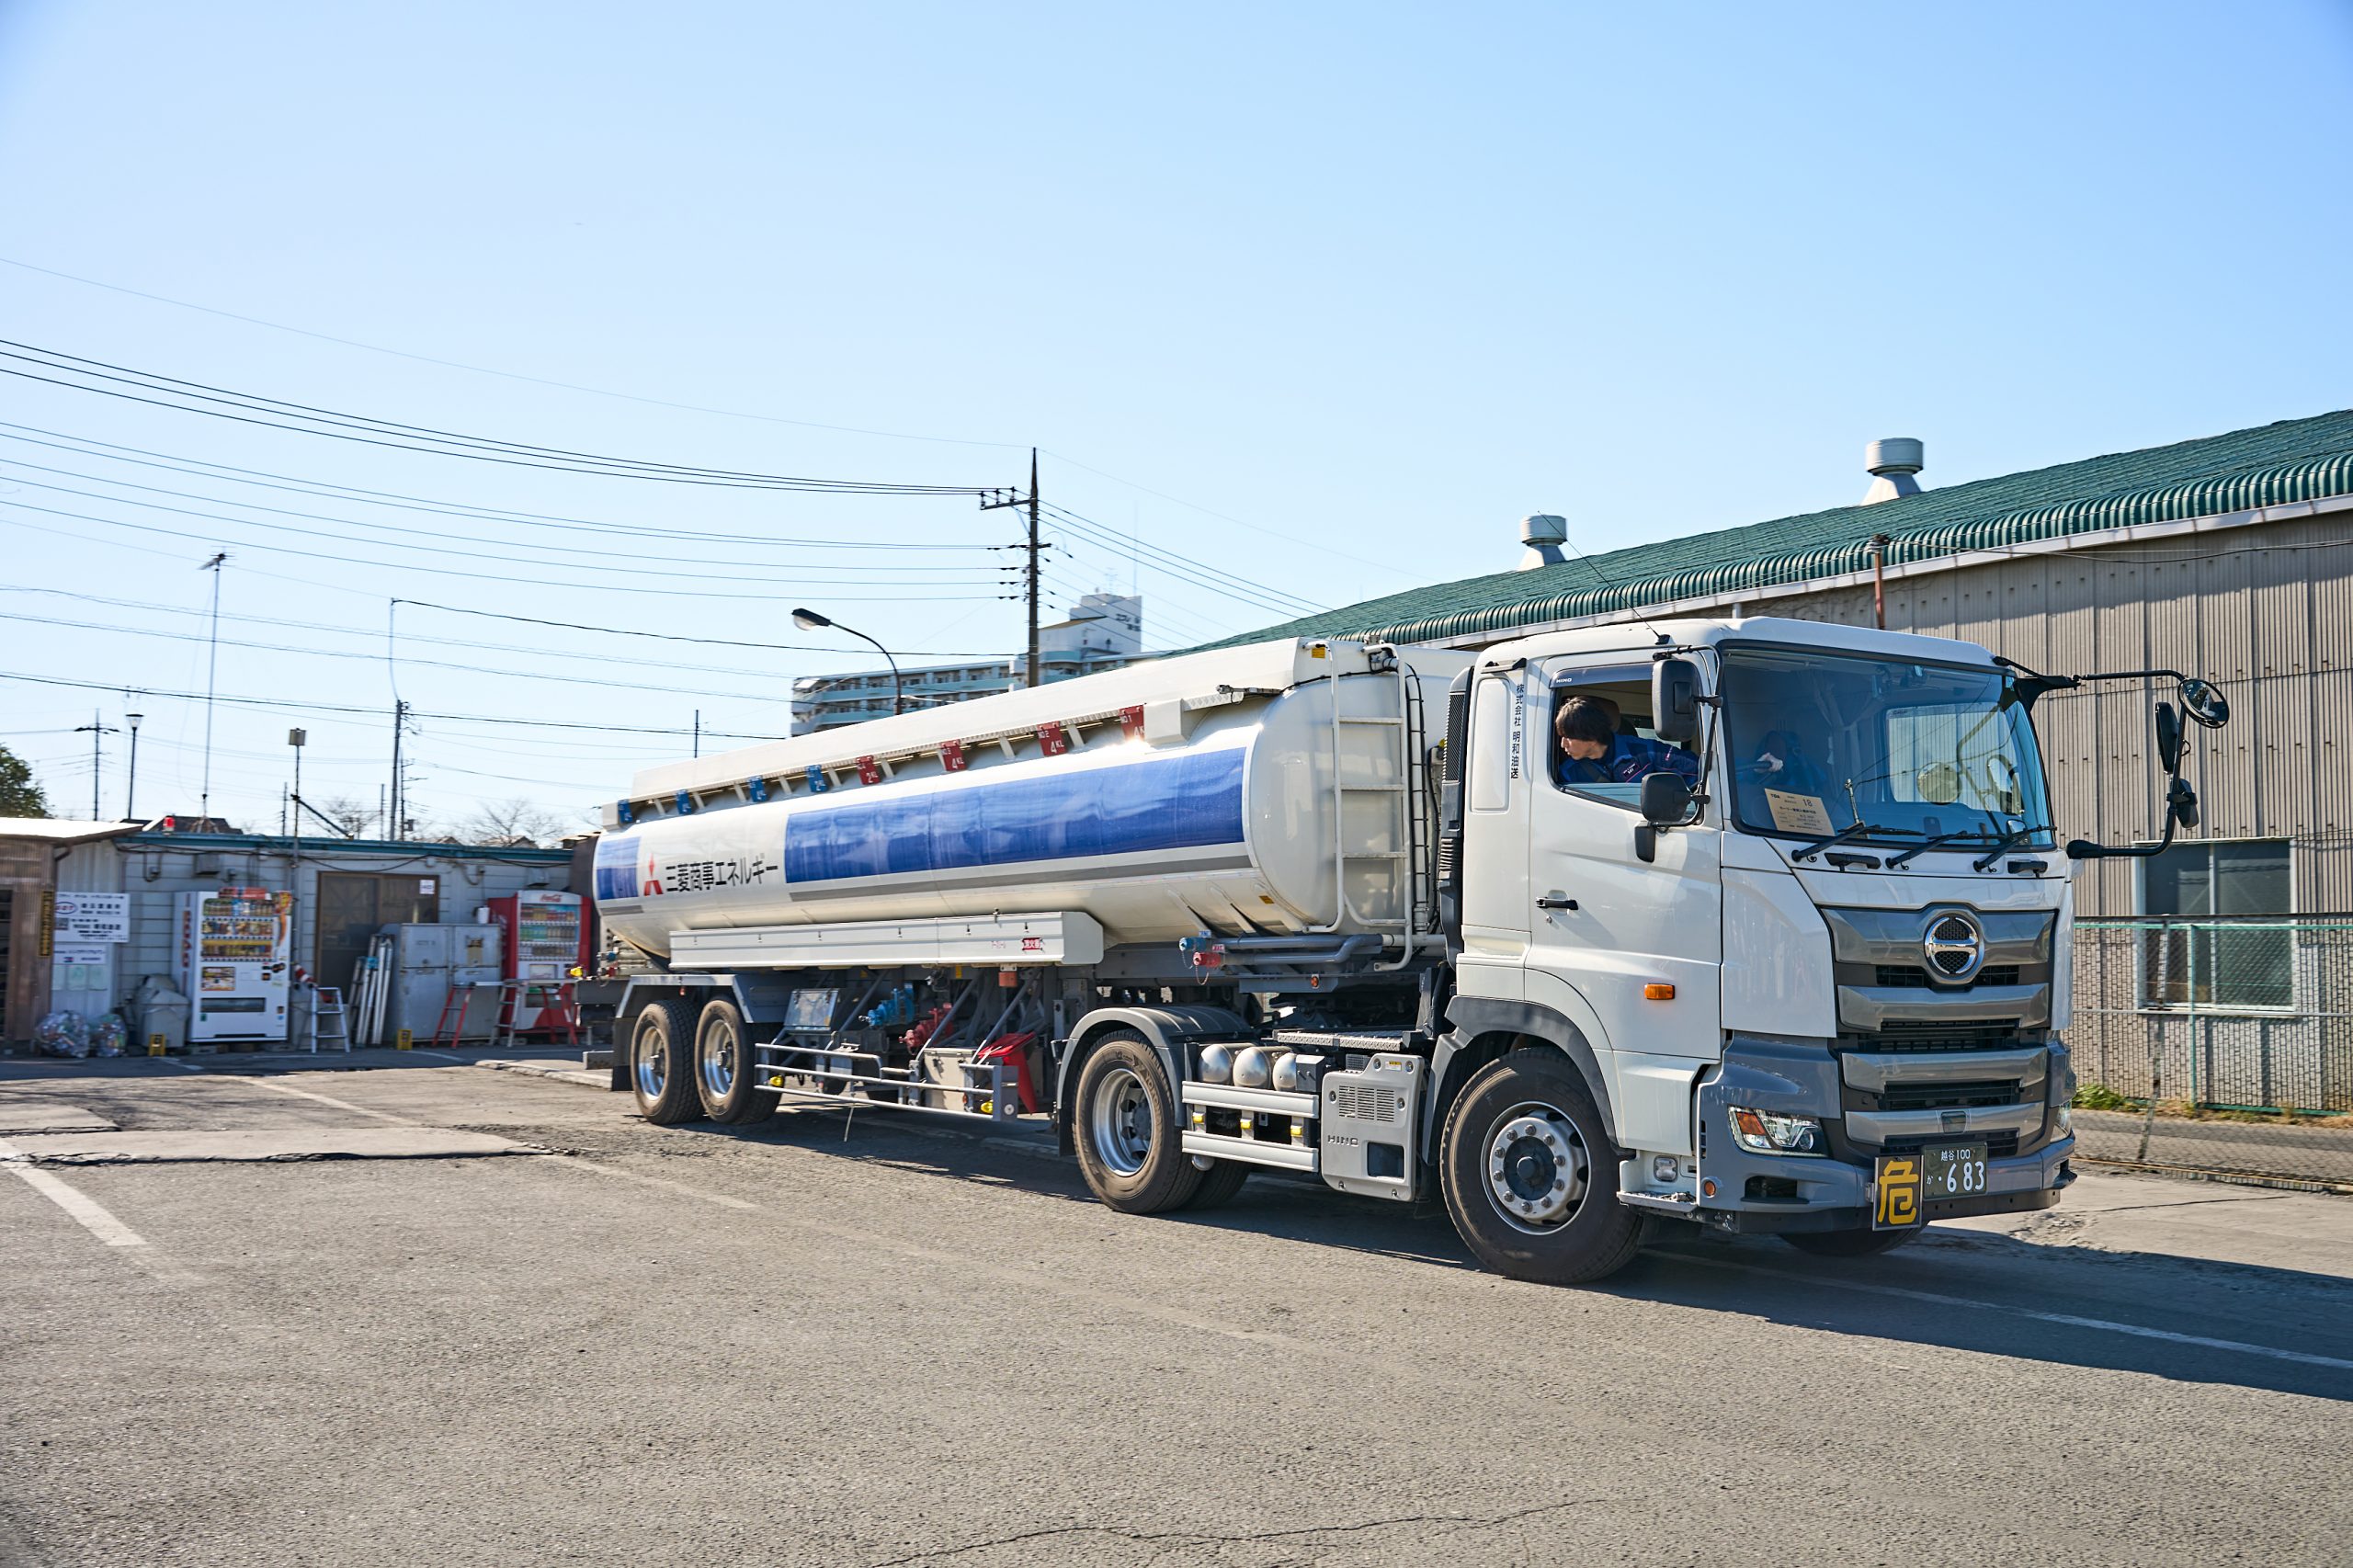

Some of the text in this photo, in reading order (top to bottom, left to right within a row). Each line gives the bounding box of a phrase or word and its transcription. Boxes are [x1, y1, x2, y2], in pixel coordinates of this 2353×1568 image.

[1511, 684, 1525, 779] 株式会社 明和油送
[665, 852, 779, 892] 三菱商事エネルギー
[1327, 1134, 1358, 1146] HINO
[1941, 1149, 1971, 1161] 越谷 100
[1877, 1160, 1918, 1224] 危
